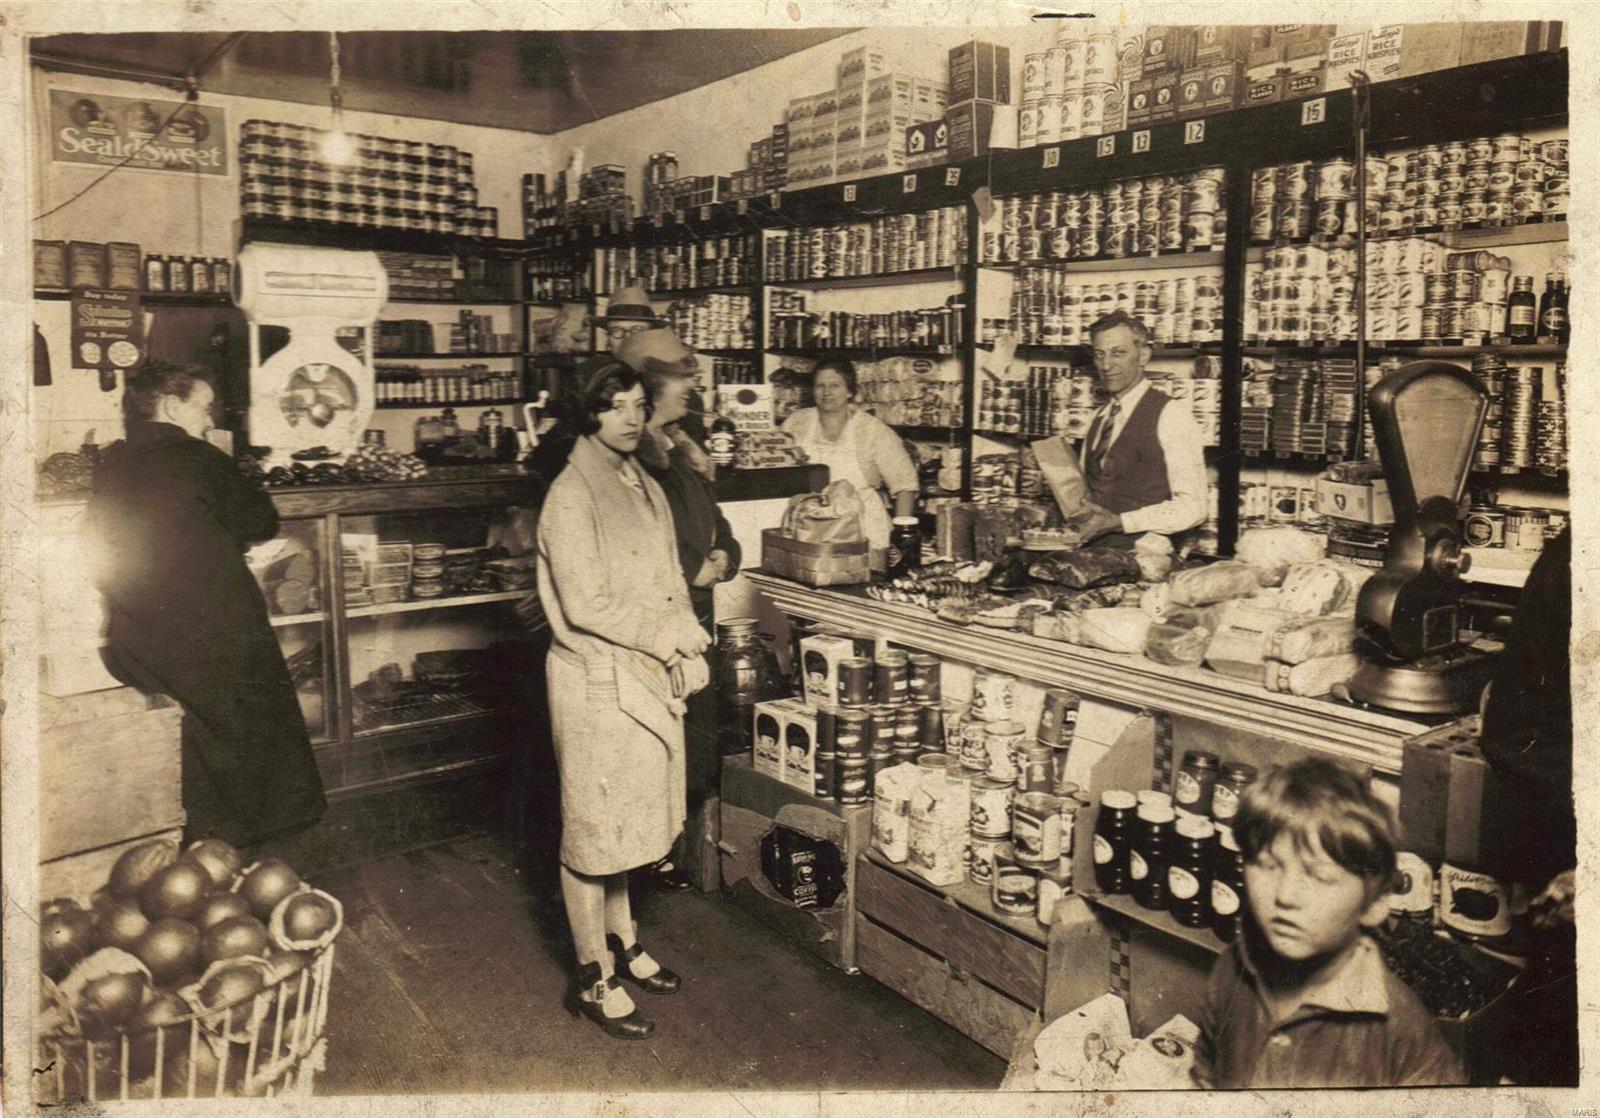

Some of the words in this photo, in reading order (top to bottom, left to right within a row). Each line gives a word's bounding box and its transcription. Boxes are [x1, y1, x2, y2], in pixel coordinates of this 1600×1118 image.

[1332, 48, 1357, 59] RICE
[1367, 48, 1402, 60] KRISPIES
[1371, 39, 1397, 51] RICE
[1306, 102, 1321, 123] 15
[1189, 122, 1204, 141] 12
[1099, 137, 1113, 156] 15
[1135, 133, 1148, 151] 13
